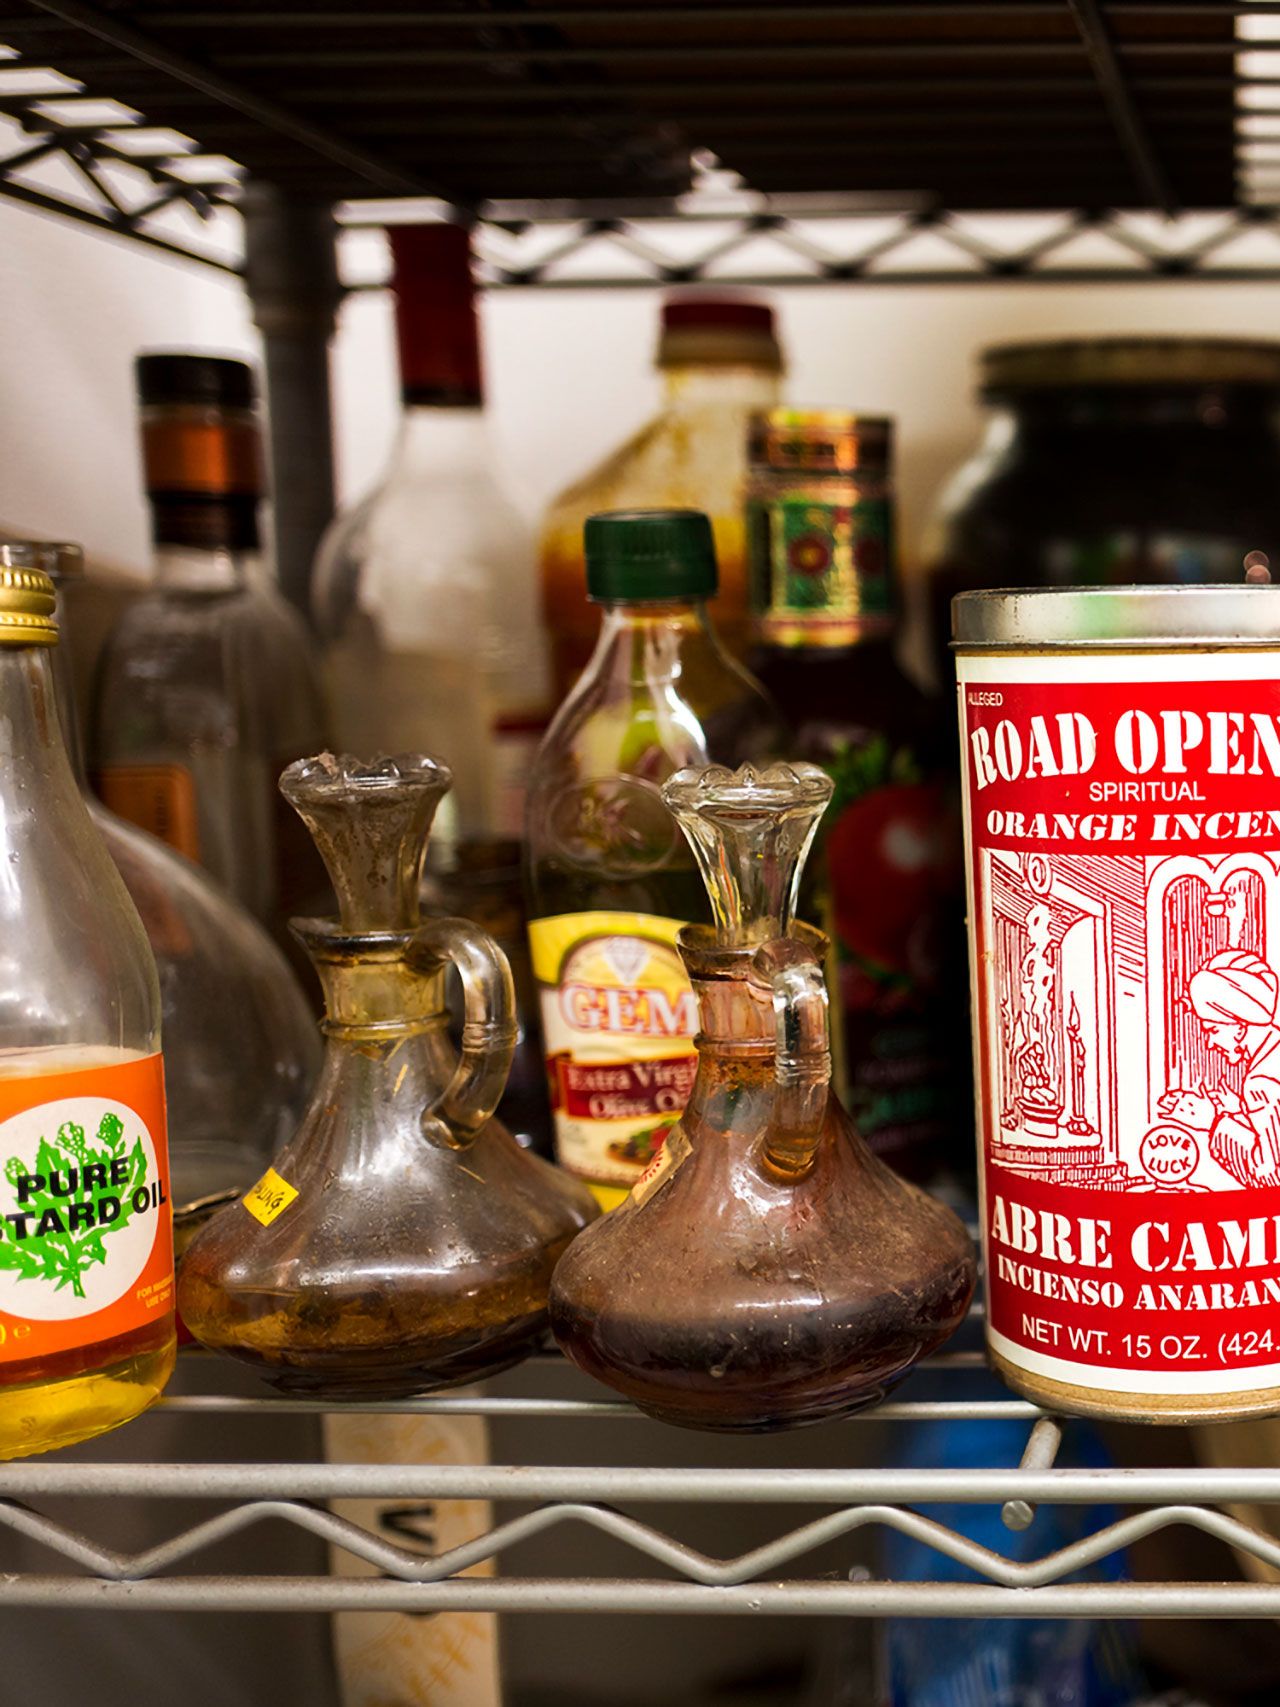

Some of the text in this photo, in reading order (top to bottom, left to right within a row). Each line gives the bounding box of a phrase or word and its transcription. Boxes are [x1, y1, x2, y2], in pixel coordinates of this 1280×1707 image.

[968, 692, 1003, 706] ALLEGED
[970, 711, 1097, 791] ROAD
[1089, 781, 1206, 802] SPIRITUAL
[987, 809, 1138, 841] ORANGE
[561, 983, 699, 1037] GEM
[1148, 1134, 1192, 1150] LOVE
[1148, 1156, 1192, 1175] LUCK
[17, 1157, 129, 1204] PURE
[0, 1180, 167, 1241] TARD OIL
[991, 1195, 1113, 1269] ABRE
[997, 1253, 1124, 1309] INCIENSO
[1022, 1313, 1062, 1346] NET
[1067, 1325, 1111, 1355] WT.
[1121, 1335, 1151, 1358] 15
[1160, 1335, 1208, 1360] OZ.
